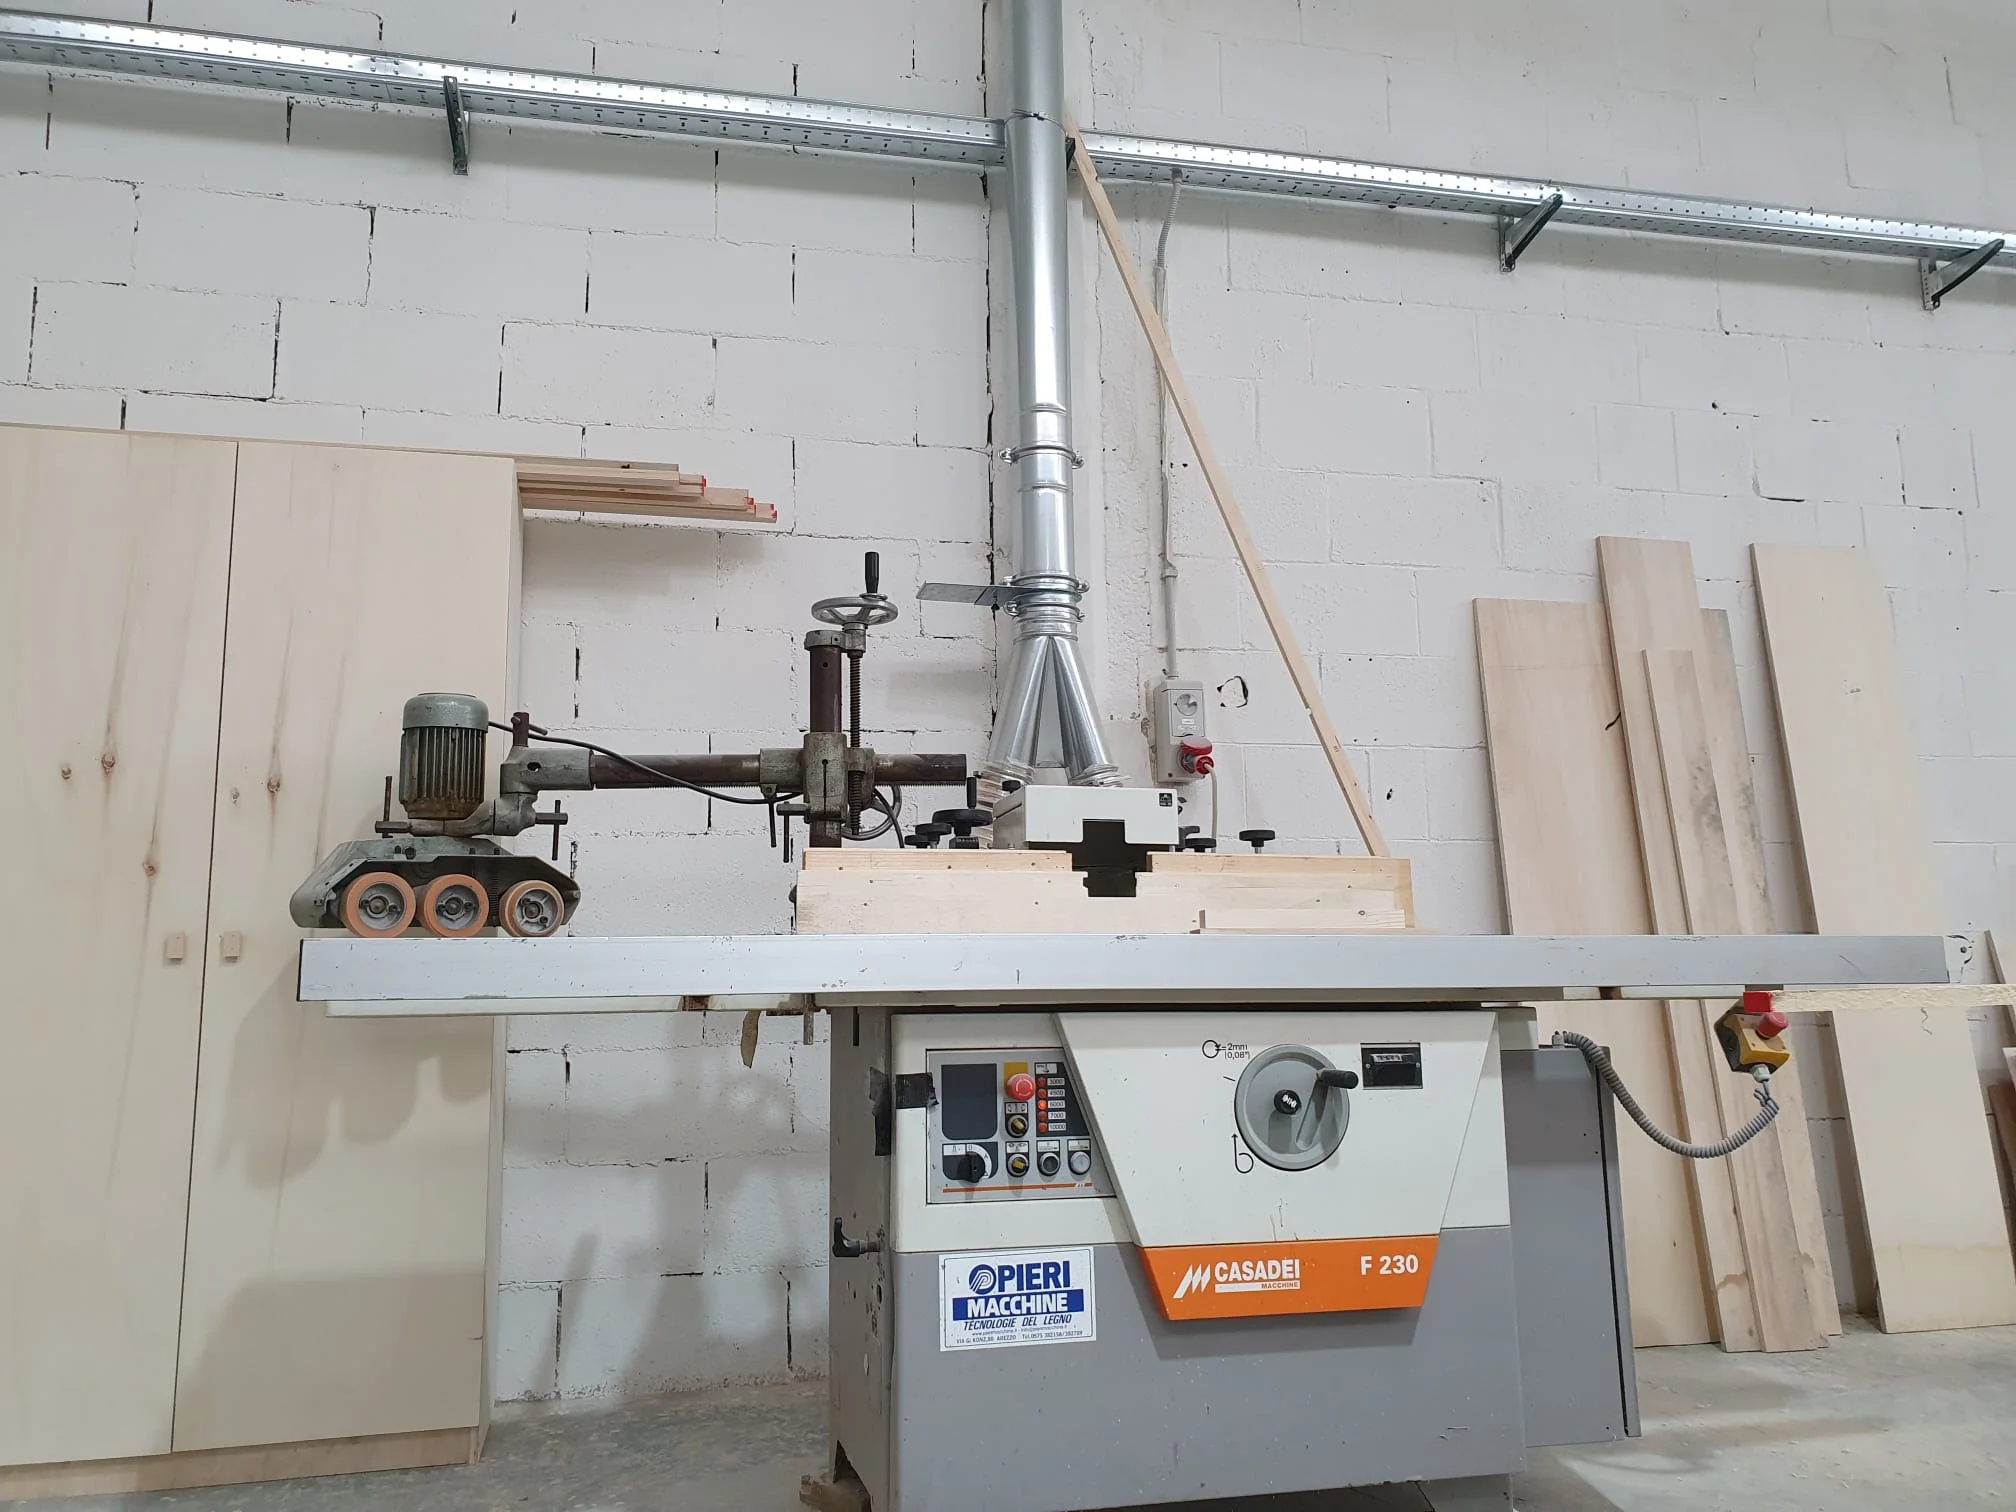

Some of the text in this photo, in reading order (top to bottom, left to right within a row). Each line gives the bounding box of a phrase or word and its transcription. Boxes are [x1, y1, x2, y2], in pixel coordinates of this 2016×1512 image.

[997, 1260, 1071, 1293] PIERI
[1214, 1258, 1300, 1283] CASADEI
[1360, 1254, 1419, 1276] F 230
[967, 1292, 1068, 1318] MACCHINE
[963, 1316, 1015, 1331] TECNOLOGIE
[1022, 1315, 1038, 1327] DEL
[1043, 1313, 1072, 1325] LEGNO
